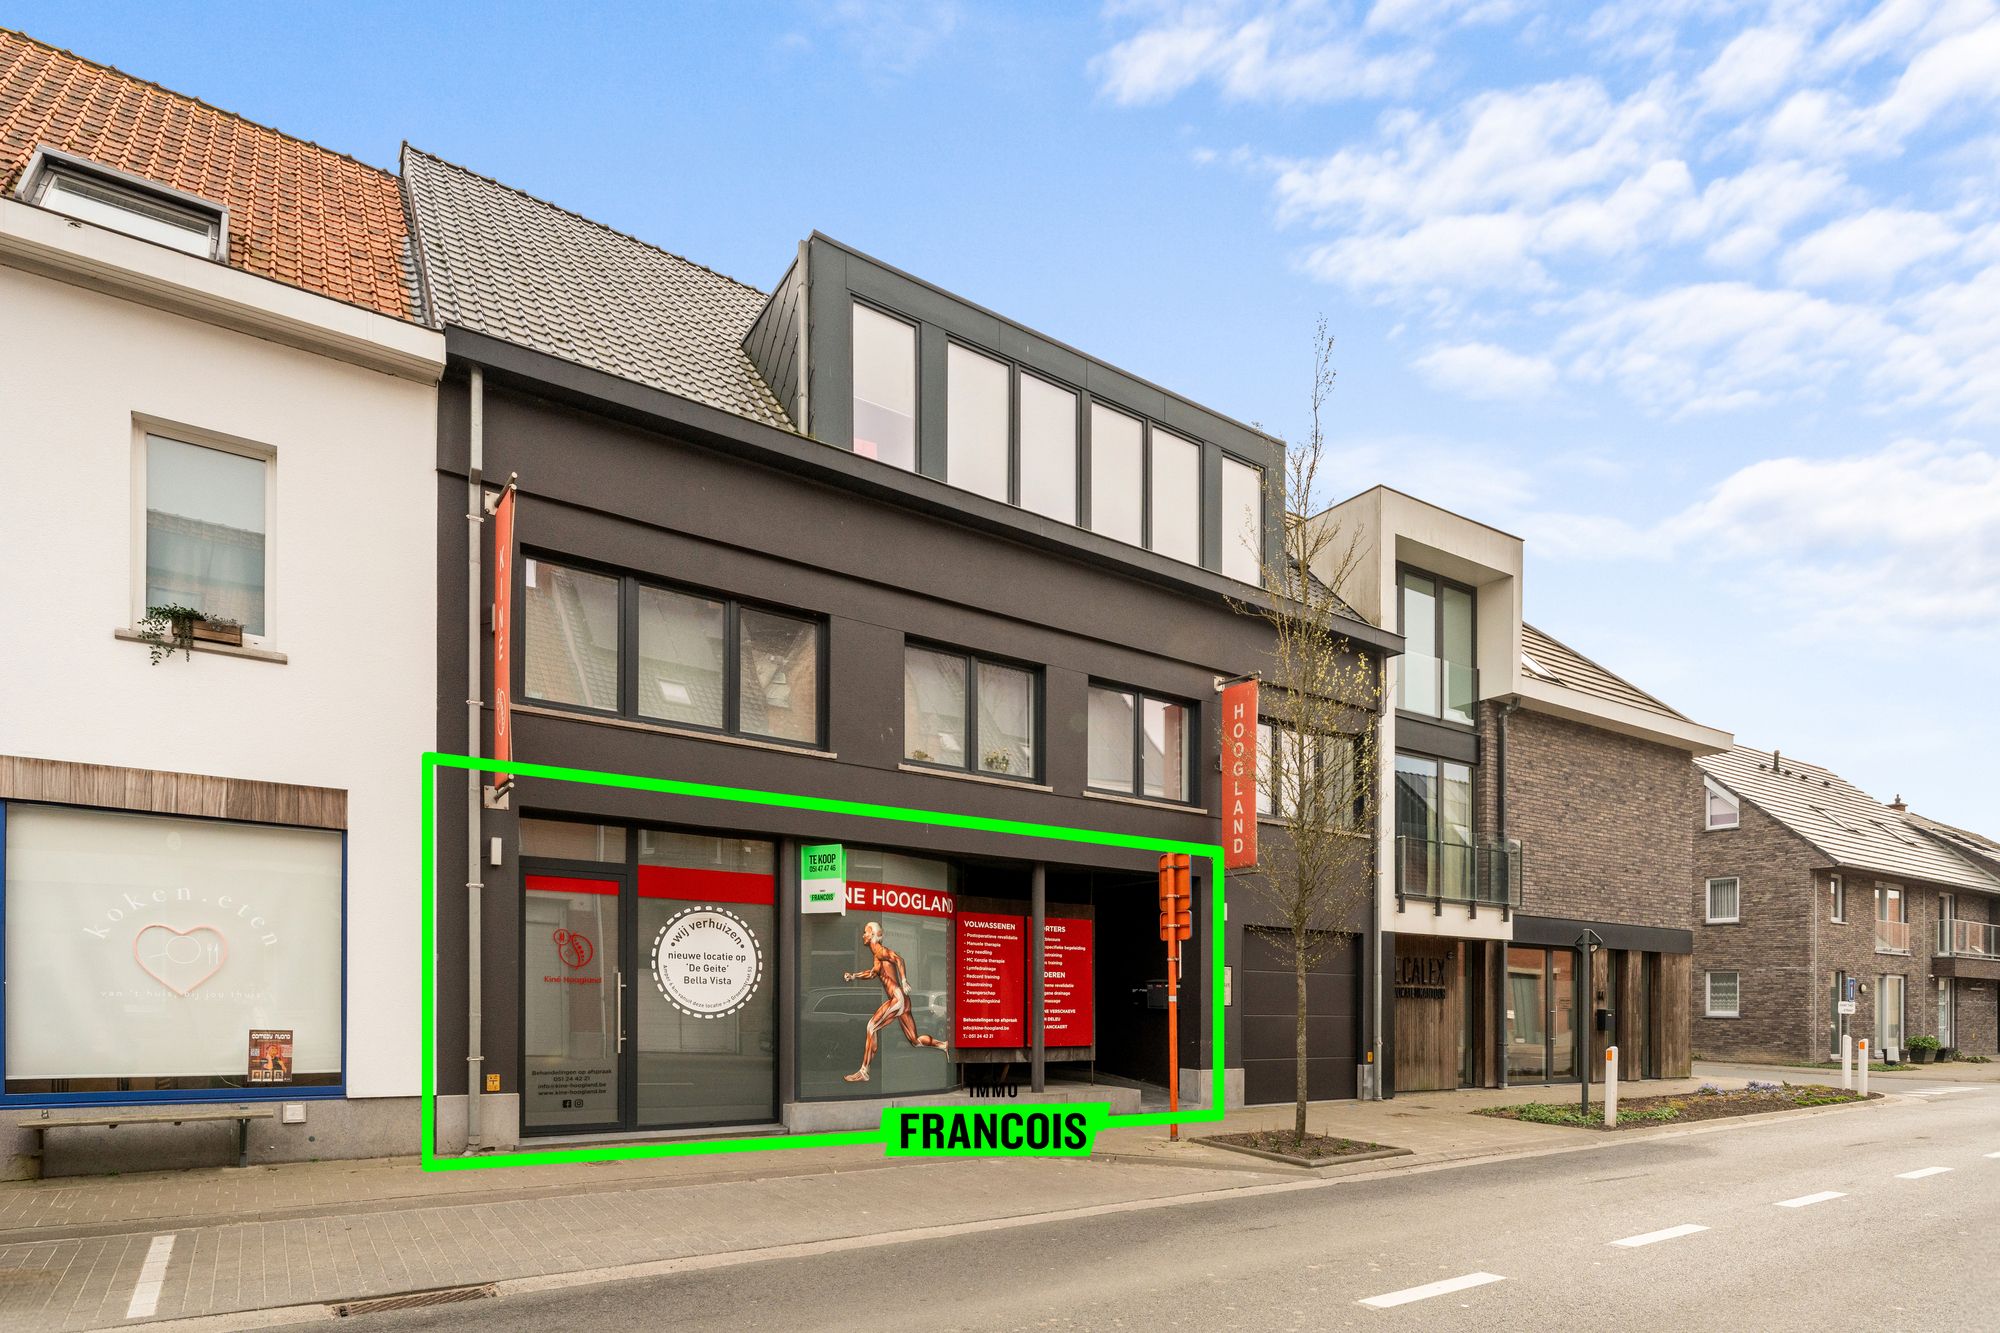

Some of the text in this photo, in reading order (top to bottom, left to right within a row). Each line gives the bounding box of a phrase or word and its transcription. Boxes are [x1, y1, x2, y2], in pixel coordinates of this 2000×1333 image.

[1233, 703, 1245, 854] HOOGLAND
[809, 853, 836, 865] TE KOOP
[811, 893, 834, 901] FRANCOIS
[844, 887, 954, 914] NE HOOGLAND
[964, 920, 1016, 930] VOLWASSENEN
[672, 918, 742, 945] wij verhuizen
[668, 950, 746, 962] nieuwe locatie op
[683, 976, 732, 985] Bella Vista
[672, 985, 679, 994] km
